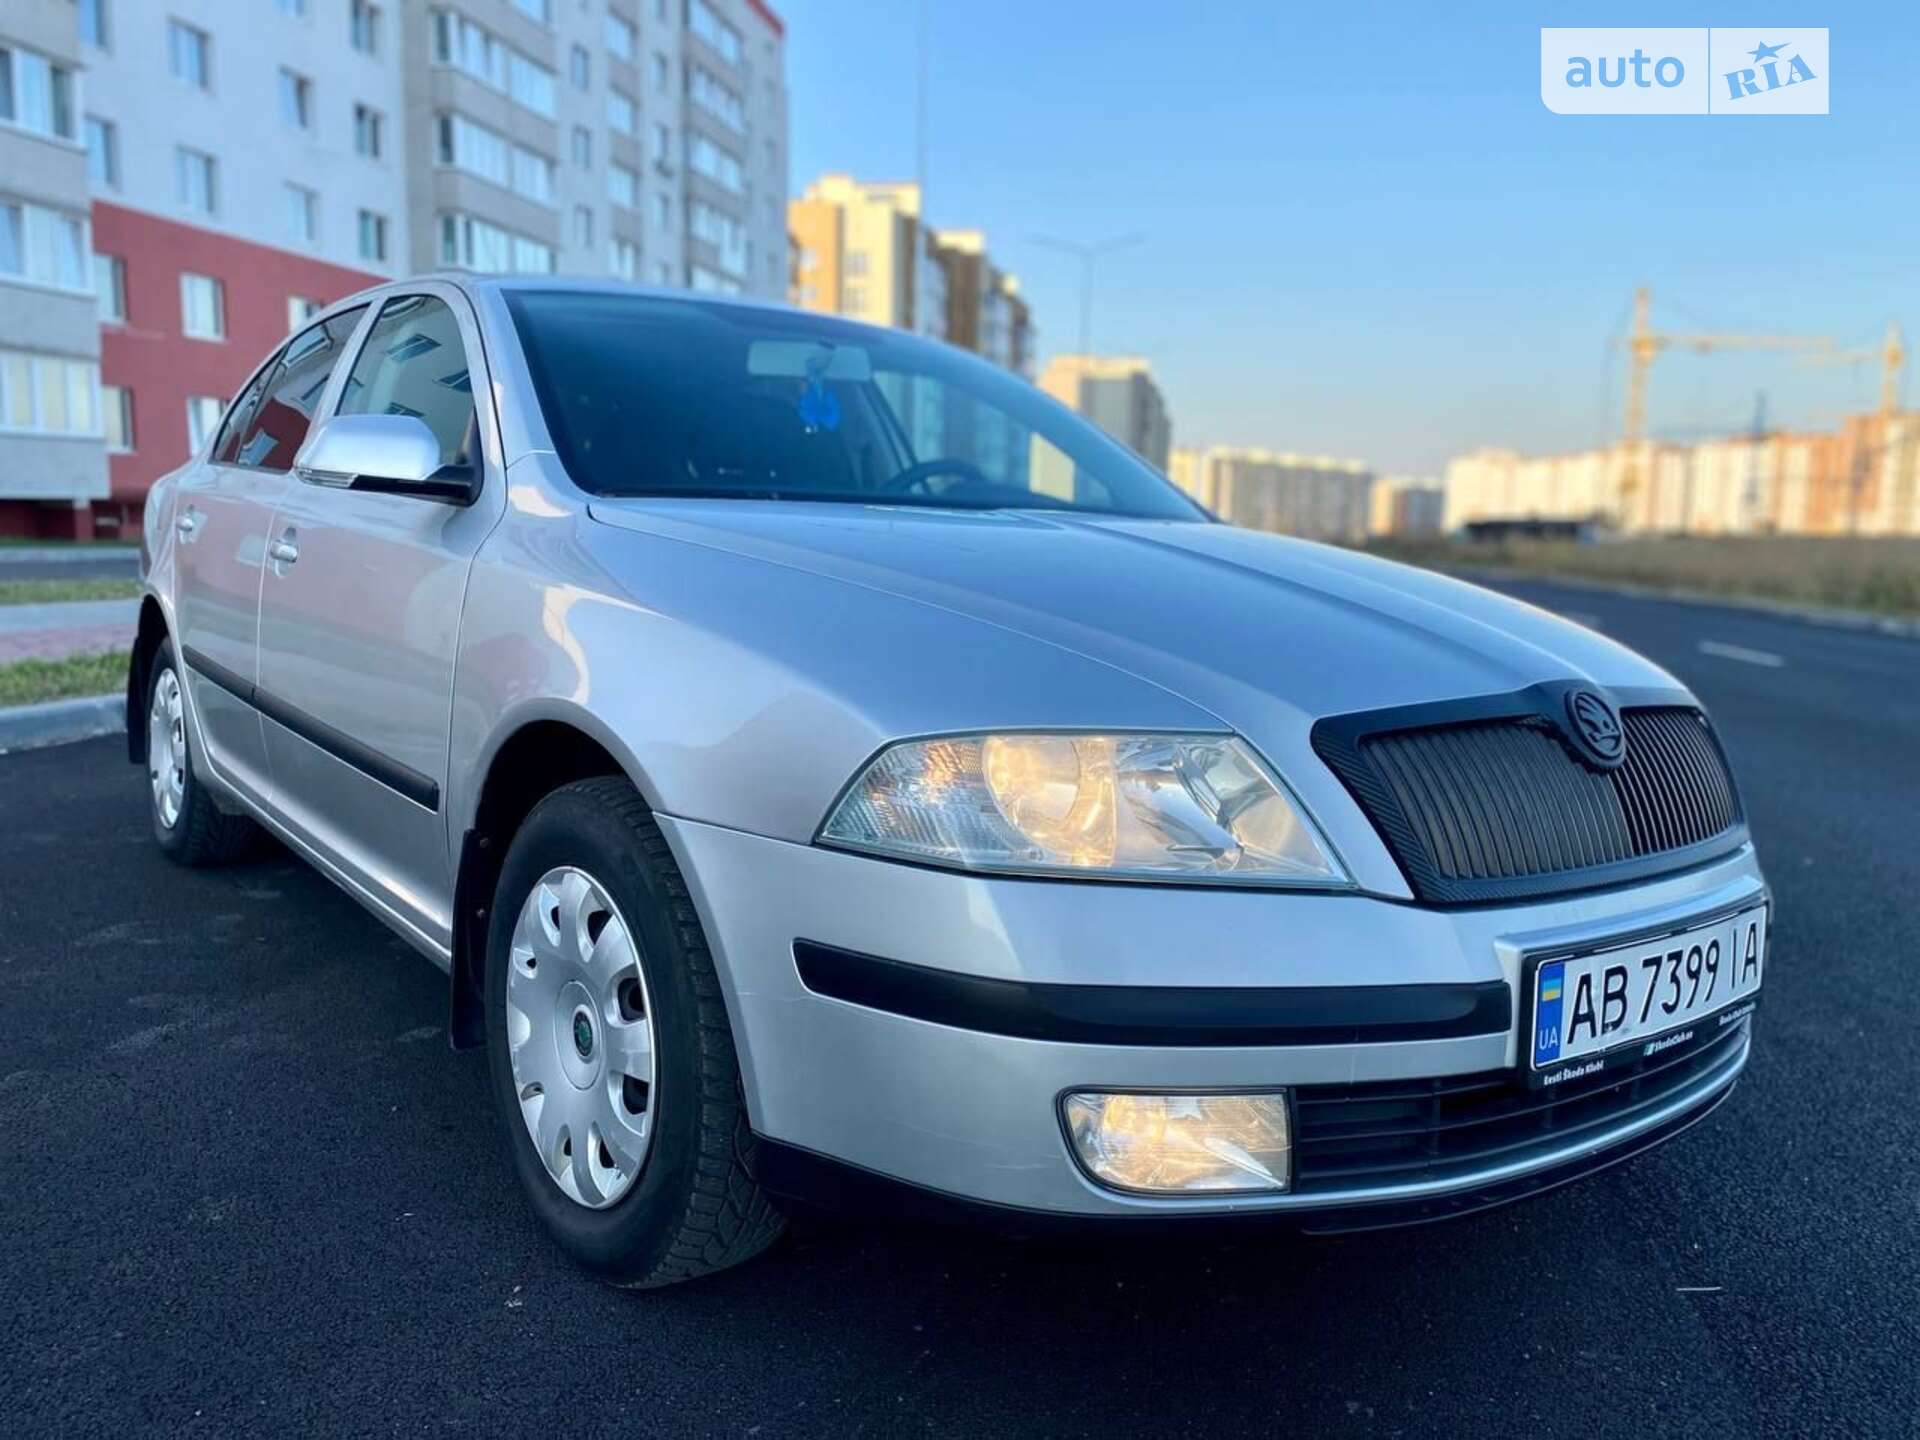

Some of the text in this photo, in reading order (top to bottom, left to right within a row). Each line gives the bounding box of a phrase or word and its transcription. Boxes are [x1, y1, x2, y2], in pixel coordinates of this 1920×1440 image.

[1567, 922, 1757, 1044] AB 7399 IA
[1539, 1026, 1559, 1050] UA
